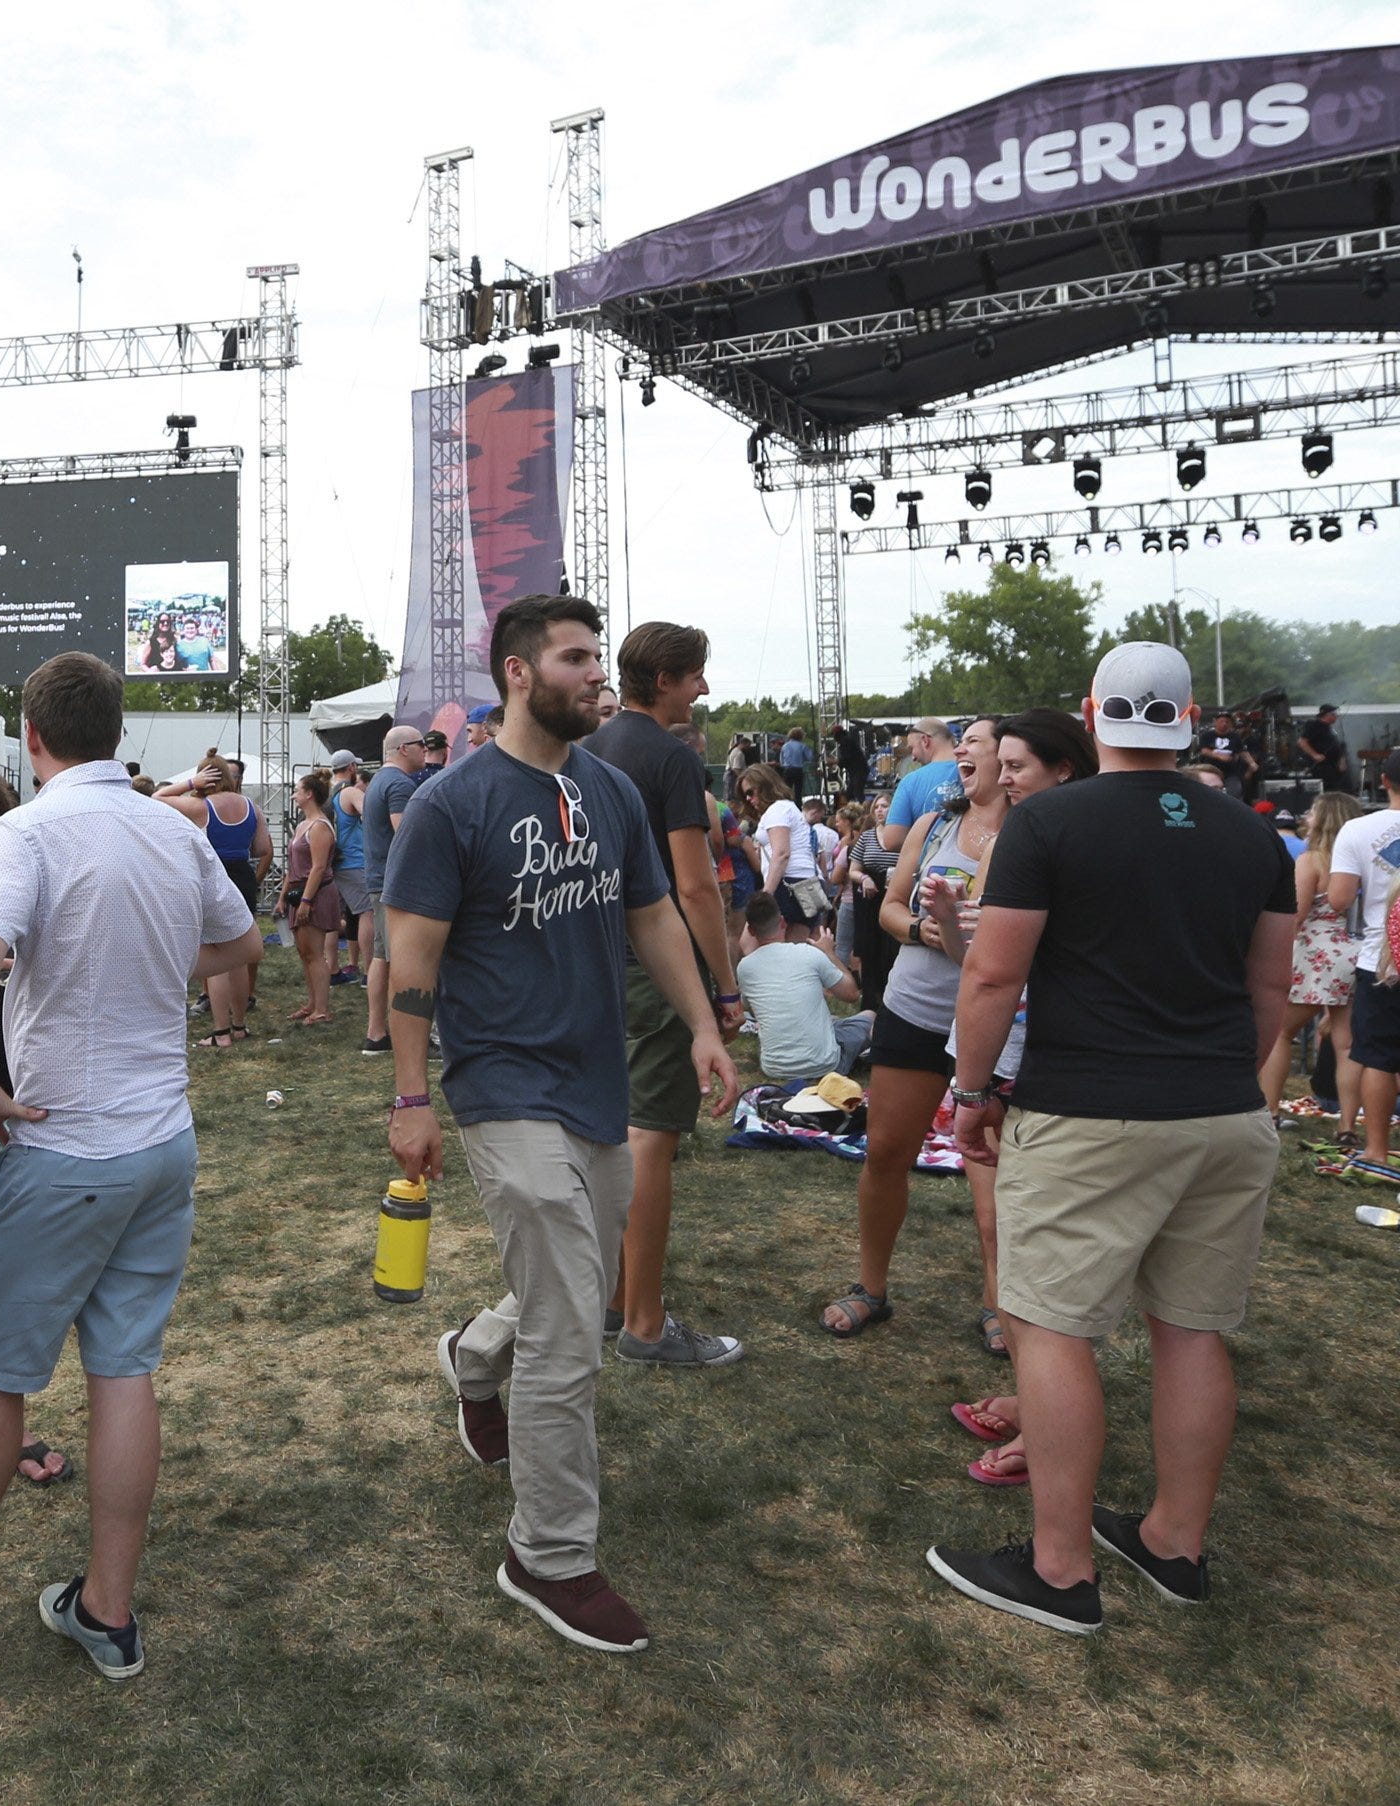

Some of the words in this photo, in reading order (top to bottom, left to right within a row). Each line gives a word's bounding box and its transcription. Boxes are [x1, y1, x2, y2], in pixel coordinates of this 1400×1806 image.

[25, 602, 34, 610] to
[34, 600, 76, 611] experience
[68, 611, 82, 620] the
[7, 624, 19, 633] for
